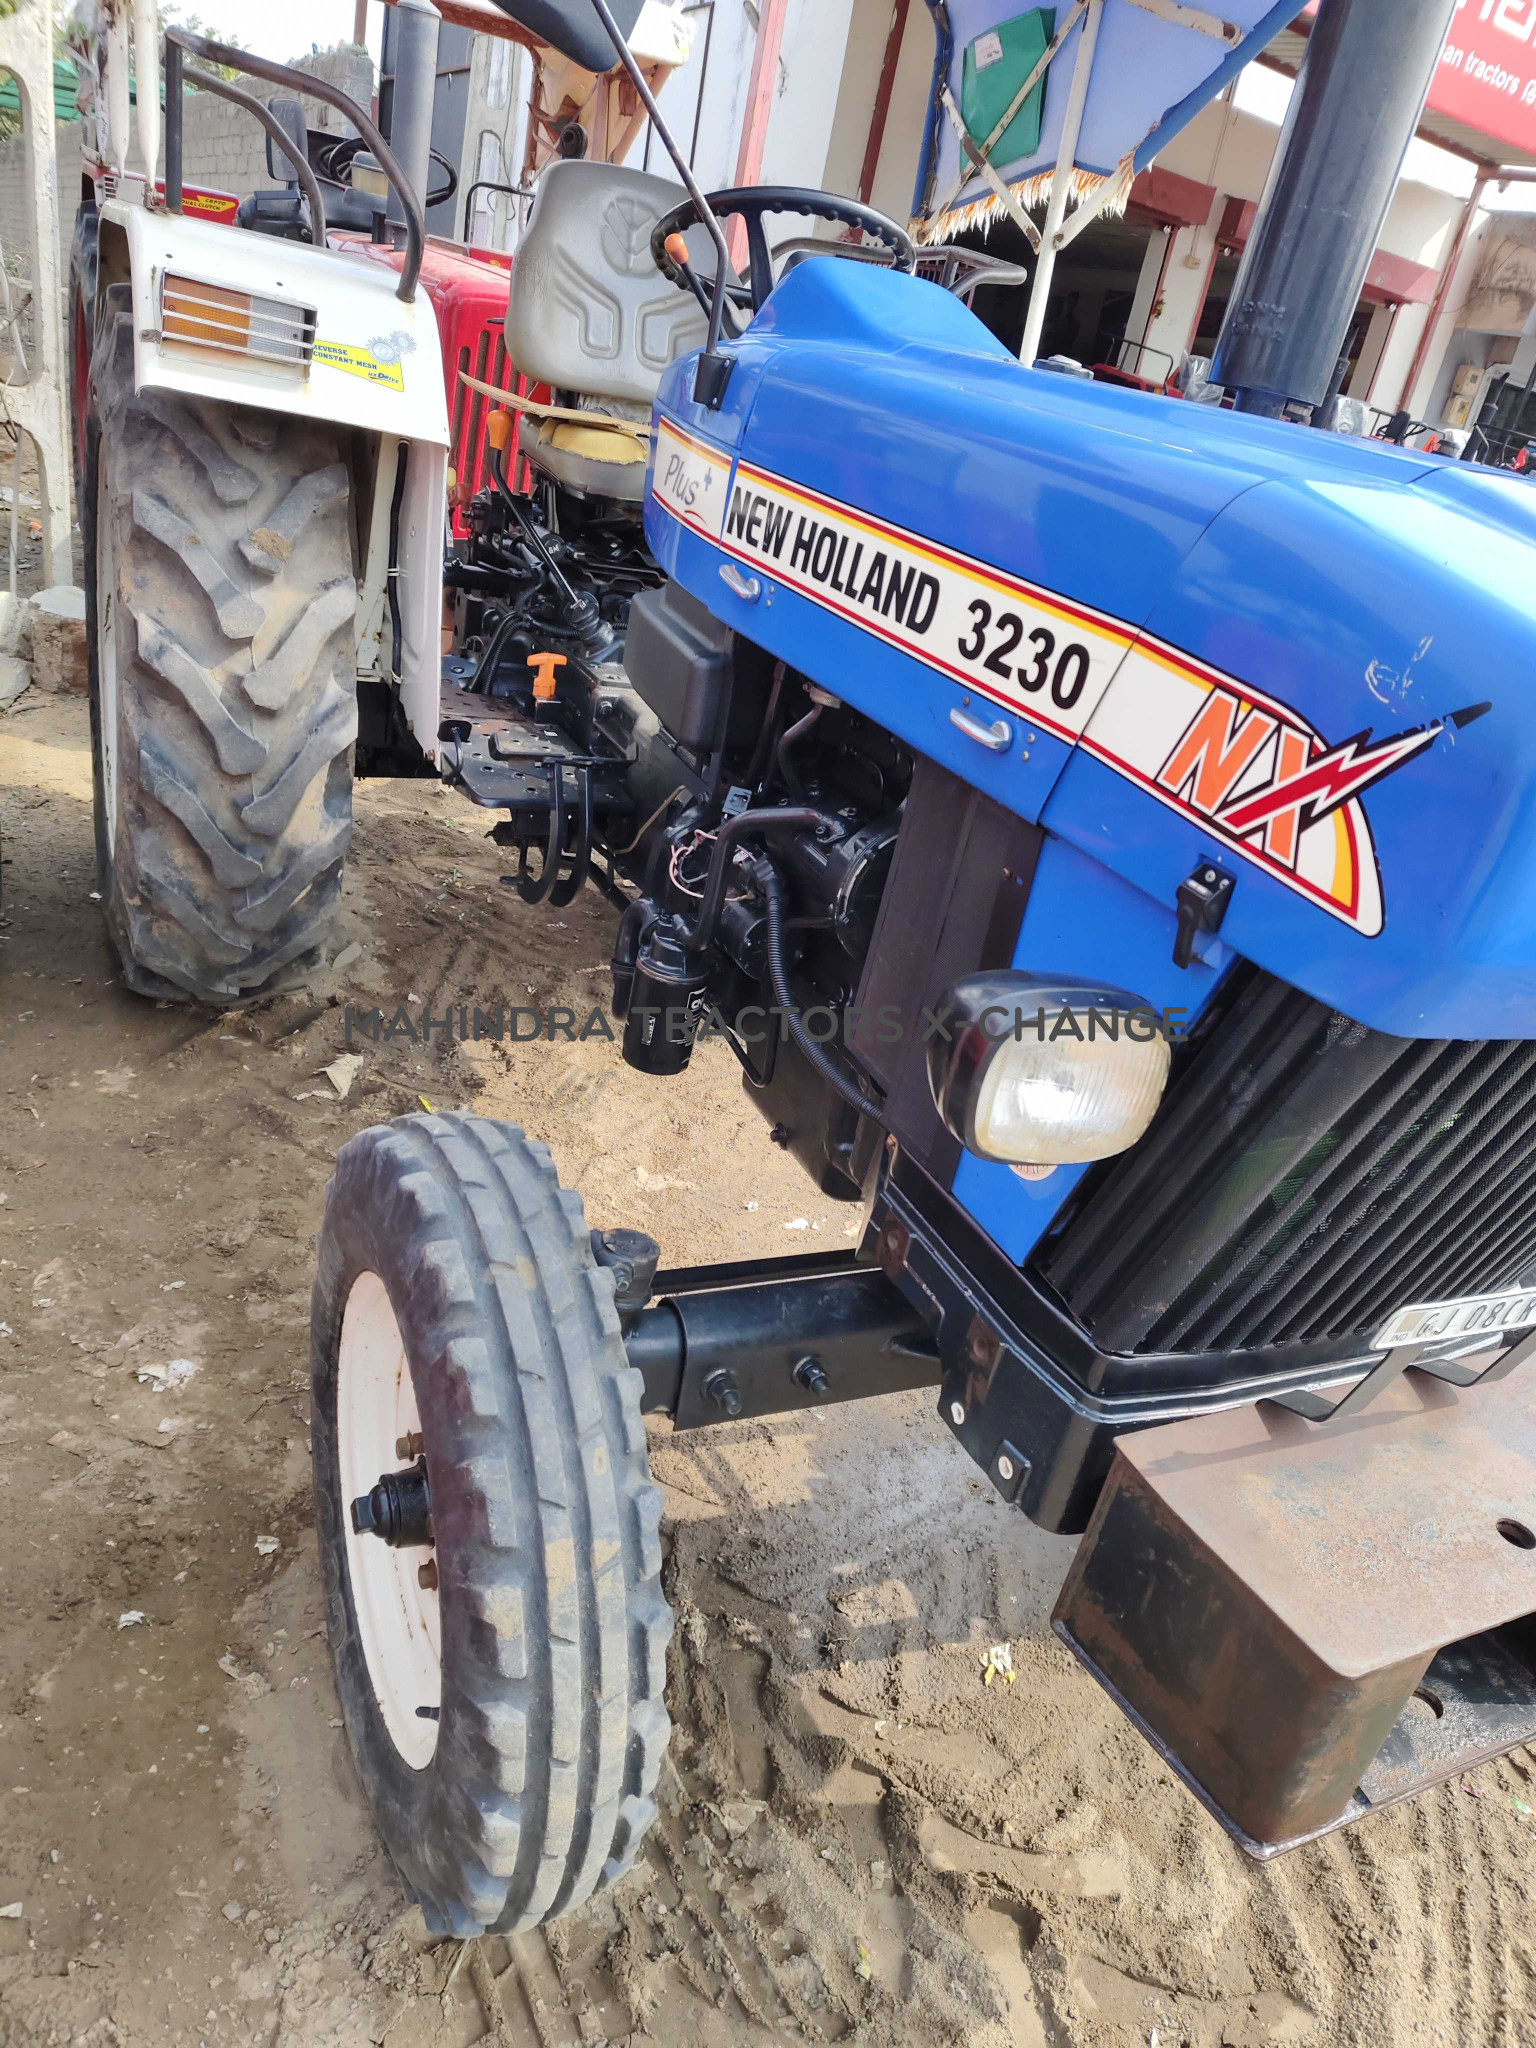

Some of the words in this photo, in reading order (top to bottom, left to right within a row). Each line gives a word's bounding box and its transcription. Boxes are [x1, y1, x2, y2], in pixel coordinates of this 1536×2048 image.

[1464, 51, 1521, 95] tractors
[198, 202, 221, 211] CLUTCH
[313, 344, 348, 355] REVERSE
[313, 350, 354, 364] CONSTANT
[356, 360, 377, 370] MESH
[727, 487, 792, 557] NEW
[790, 519, 940, 635] HOLLAND
[957, 600, 1090, 710] 3230
[1155, 686, 1405, 872] NX
[1390, 1333, 1408, 1343] IND
